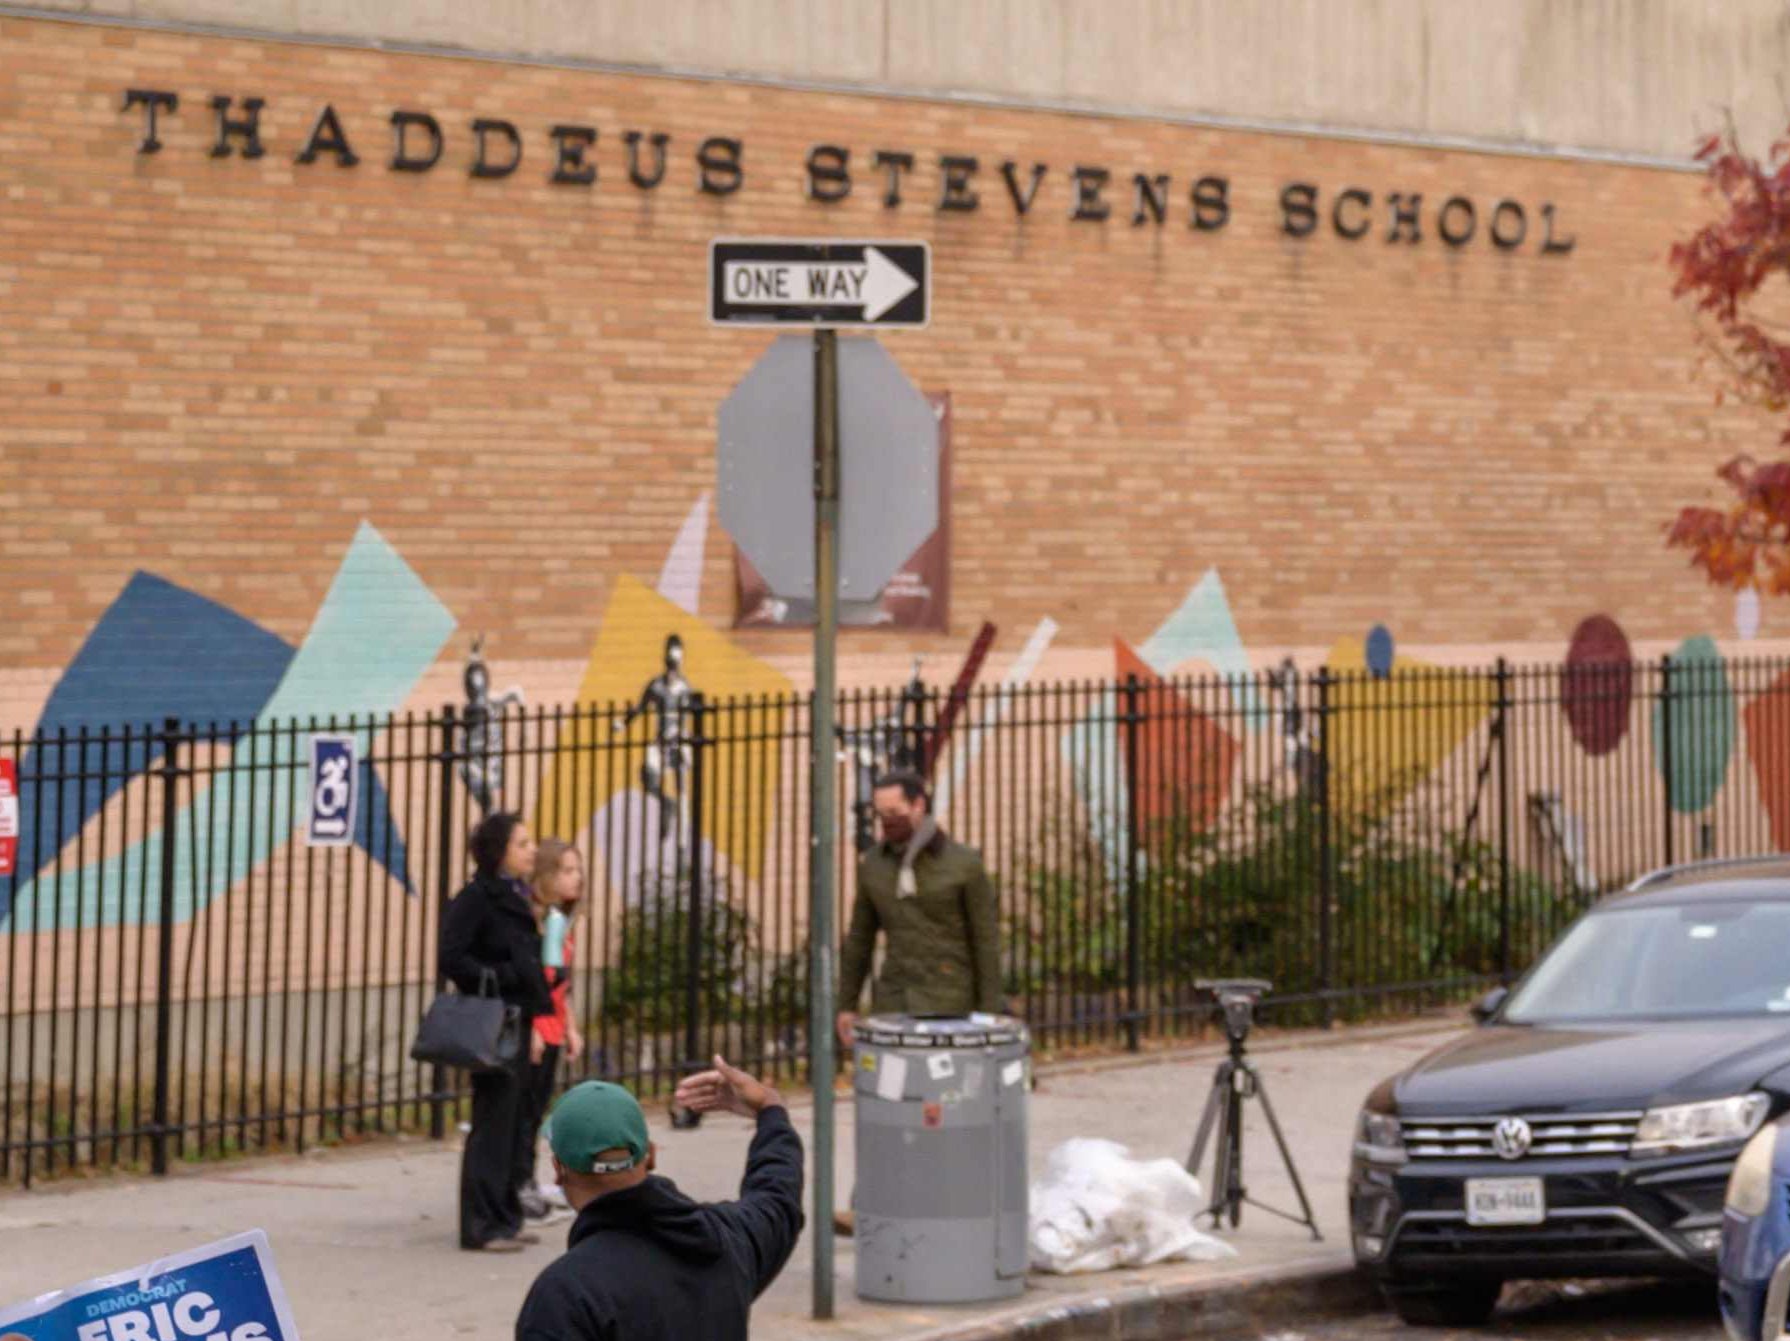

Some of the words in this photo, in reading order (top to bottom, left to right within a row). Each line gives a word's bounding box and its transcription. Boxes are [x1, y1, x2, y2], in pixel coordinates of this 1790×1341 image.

[122, 88, 745, 195] THADDEUS
[805, 142, 1233, 234] STEVENS
[1278, 180, 1577, 257] SCHOOL
[734, 266, 790, 299] ONE
[808, 267, 868, 299] WAY
[86, 1278, 188, 1318] DEMOCRAT
